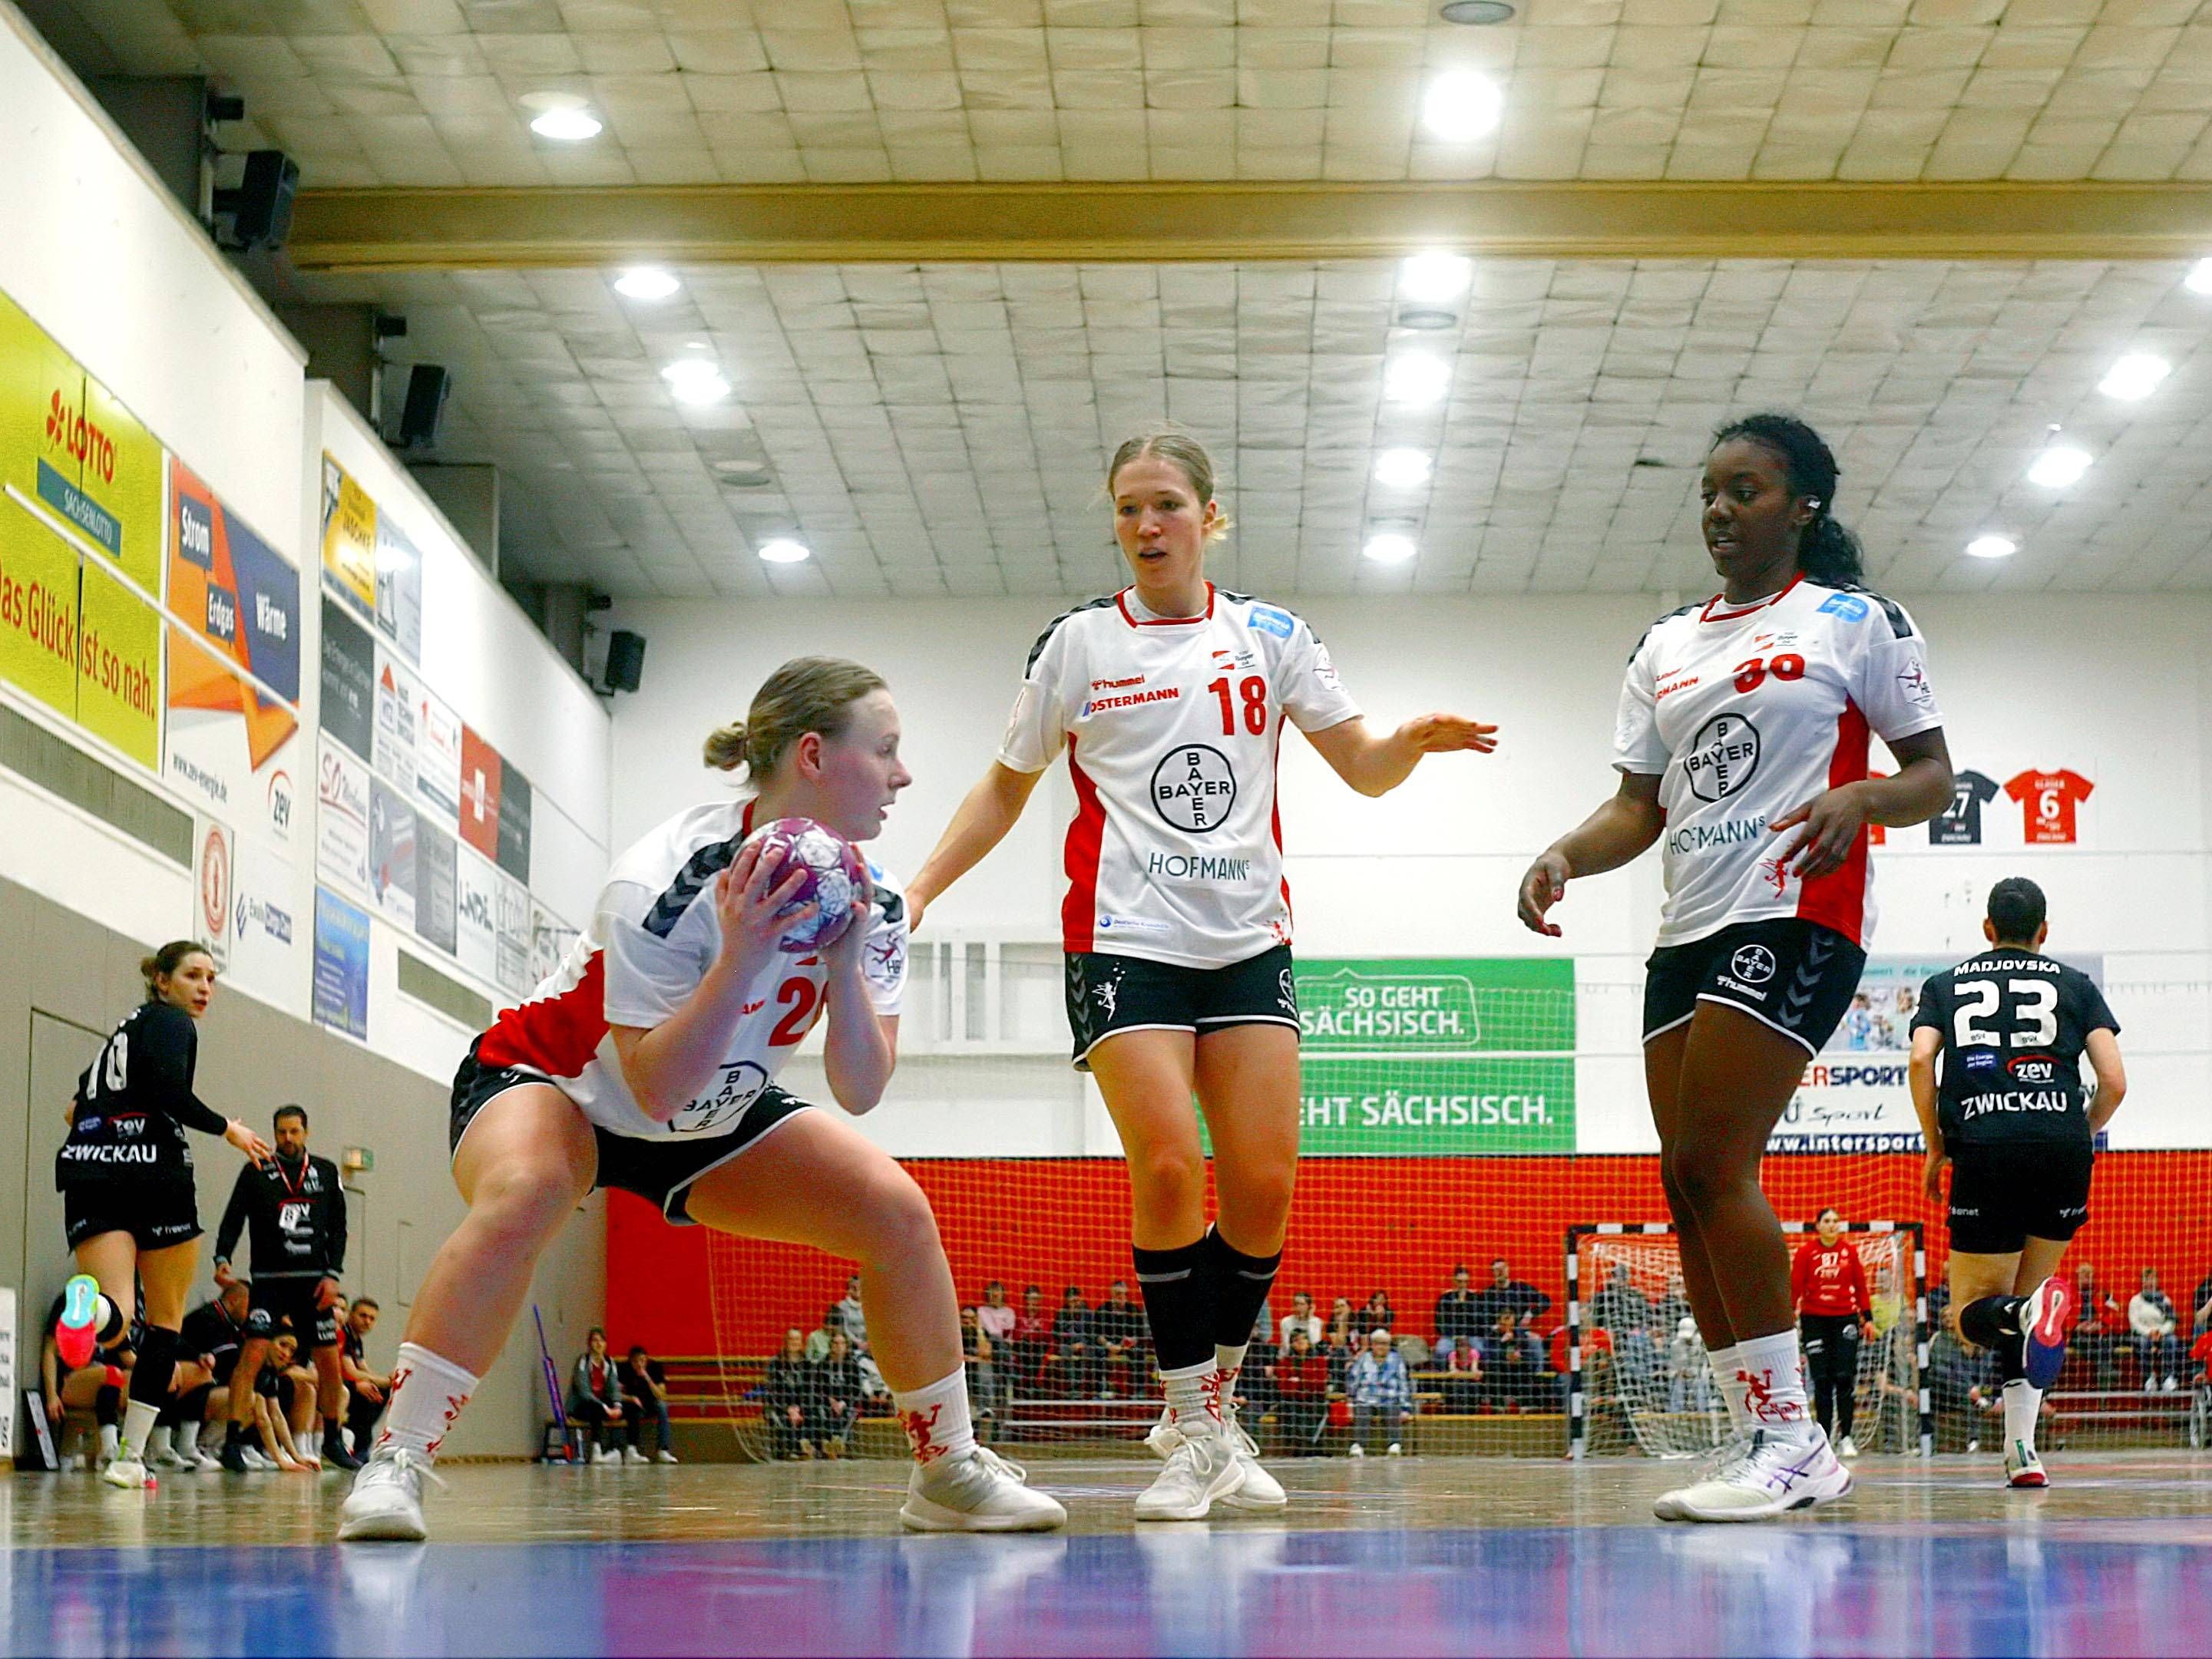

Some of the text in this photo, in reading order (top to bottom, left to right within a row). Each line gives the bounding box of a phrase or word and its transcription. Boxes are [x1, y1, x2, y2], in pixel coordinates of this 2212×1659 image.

[68, 405, 114, 484] LOTTO
[182, 505, 210, 558] Strom
[209, 592, 234, 636] Erdgas
[256, 591, 286, 640] Wärme
[0, 559, 155, 721] as Glück ist so nah.
[1103, 674, 1145, 689] hummel
[1090, 688, 1179, 713] OSTERMANN
[1208, 676, 1267, 735] 18
[1690, 742, 1754, 771] BAYER
[1159, 782, 1230, 799] BAYER
[1187, 752, 1206, 826] BAYER
[273, 790, 291, 828] zev
[2039, 790, 2060, 820] 6
[1954, 960, 2061, 977] MADJOVSKA
[768, 977, 828, 1046] 2
[1344, 986, 1443, 1008] SO GEHT
[1300, 1006, 1465, 1036] SÄCHSISCH.
[1954, 979, 2058, 1049] 23
[2015, 1063, 2052, 1079] zev
[1361, 1089, 1553, 1125] SÄCHSISCH.
[1807, 1102, 1890, 1127] Sport
[1961, 1092, 2068, 1120] ZWICKAU
[61, 1145, 157, 1163] ZWICKAU
